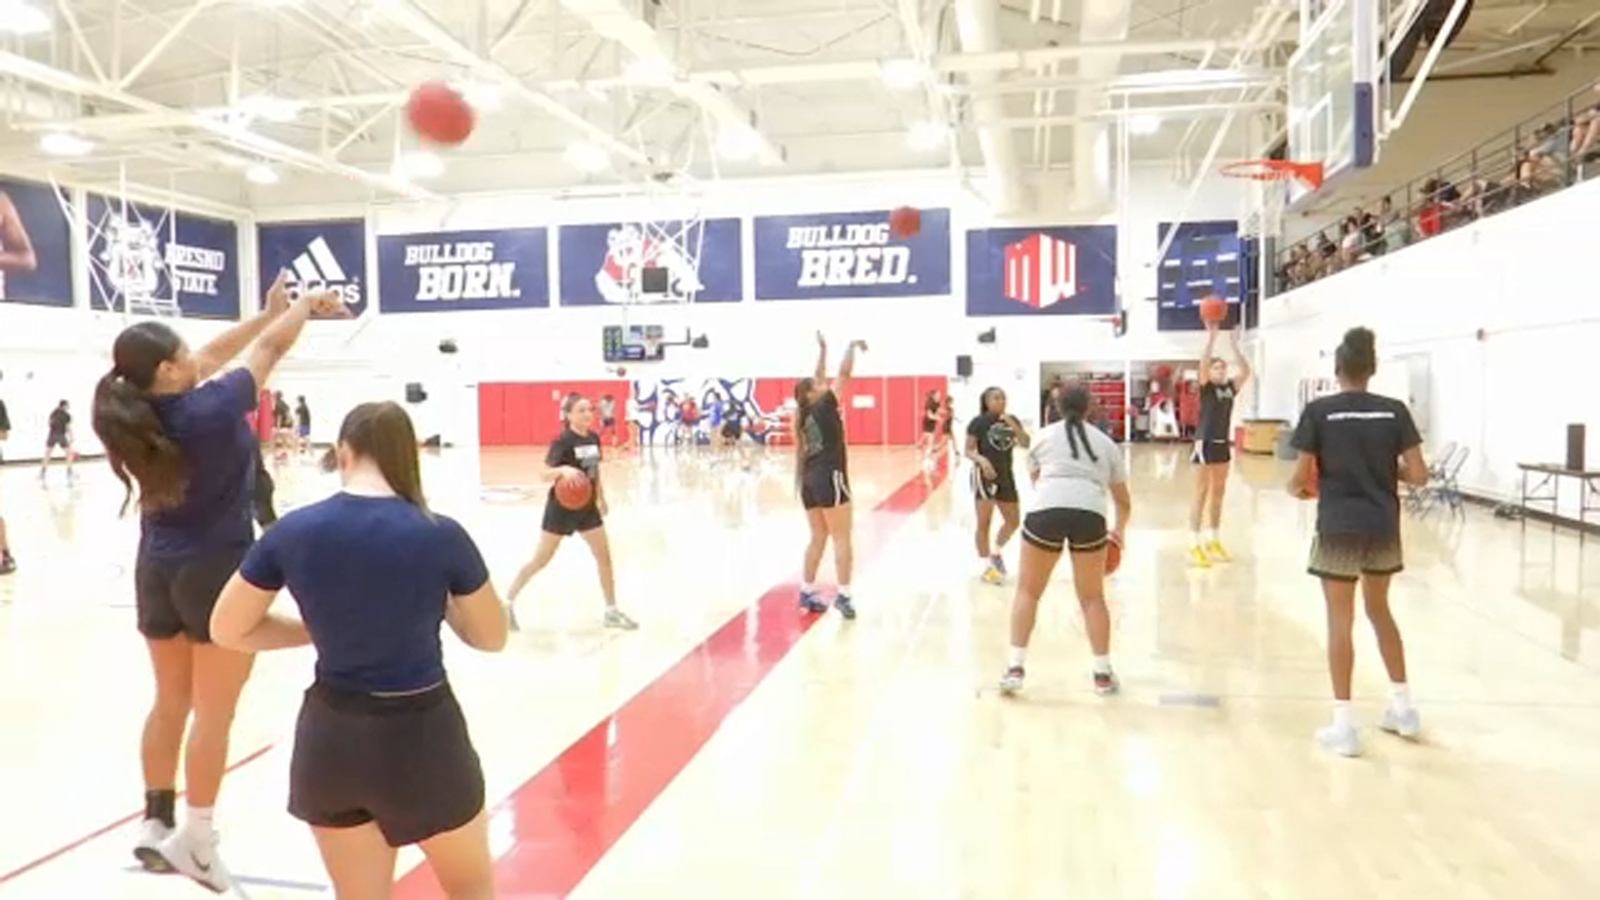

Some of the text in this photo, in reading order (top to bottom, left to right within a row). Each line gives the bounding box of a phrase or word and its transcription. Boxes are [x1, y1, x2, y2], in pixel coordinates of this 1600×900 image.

[787, 223, 890, 249] BULLDOG
[404, 242, 494, 266] BULLDOG
[798, 246, 918, 287] BRED.
[416, 262, 521, 301] BORN.
